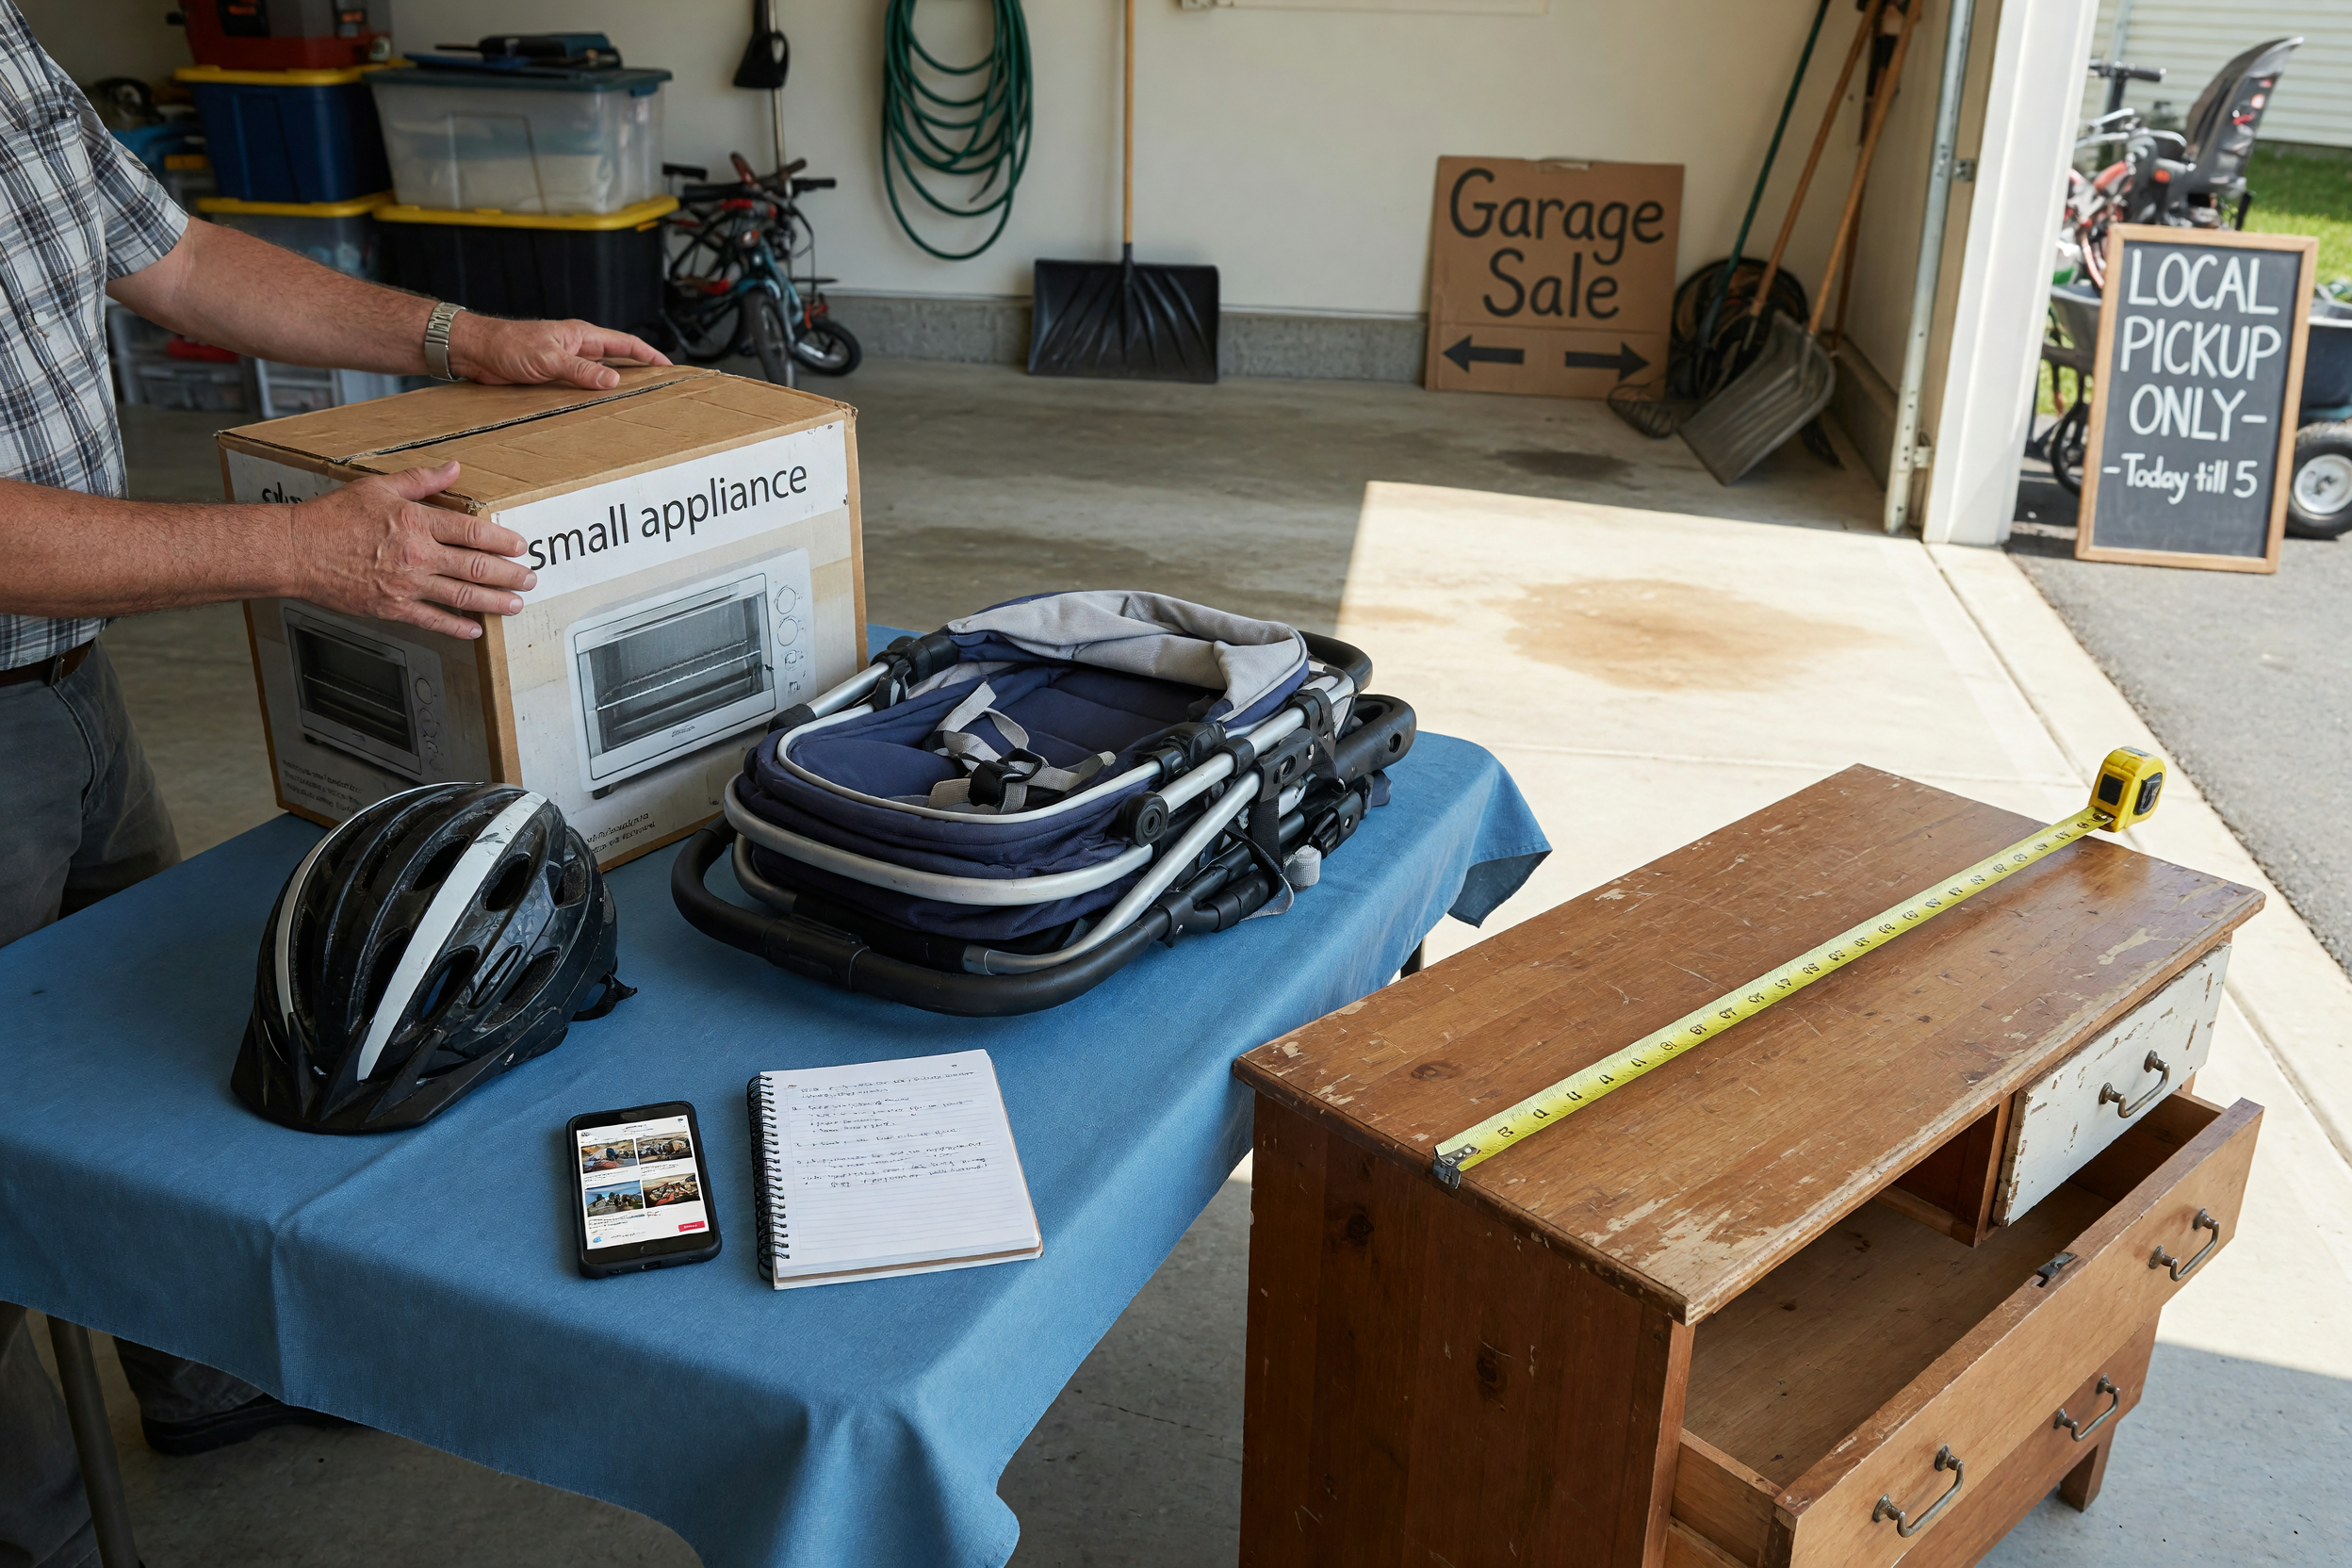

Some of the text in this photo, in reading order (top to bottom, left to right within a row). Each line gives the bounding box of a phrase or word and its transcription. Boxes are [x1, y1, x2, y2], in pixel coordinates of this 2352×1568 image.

[1449, 168, 1665, 265] Garage
[1482, 247, 1619, 319] Sale
[2128, 249, 2279, 315] LOCAL
[2120, 315, 2282, 381] PICKUP
[2194, 459, 2230, 495] till
[2233, 460, 2258, 498] 5
[528, 466, 808, 571] small appliance
